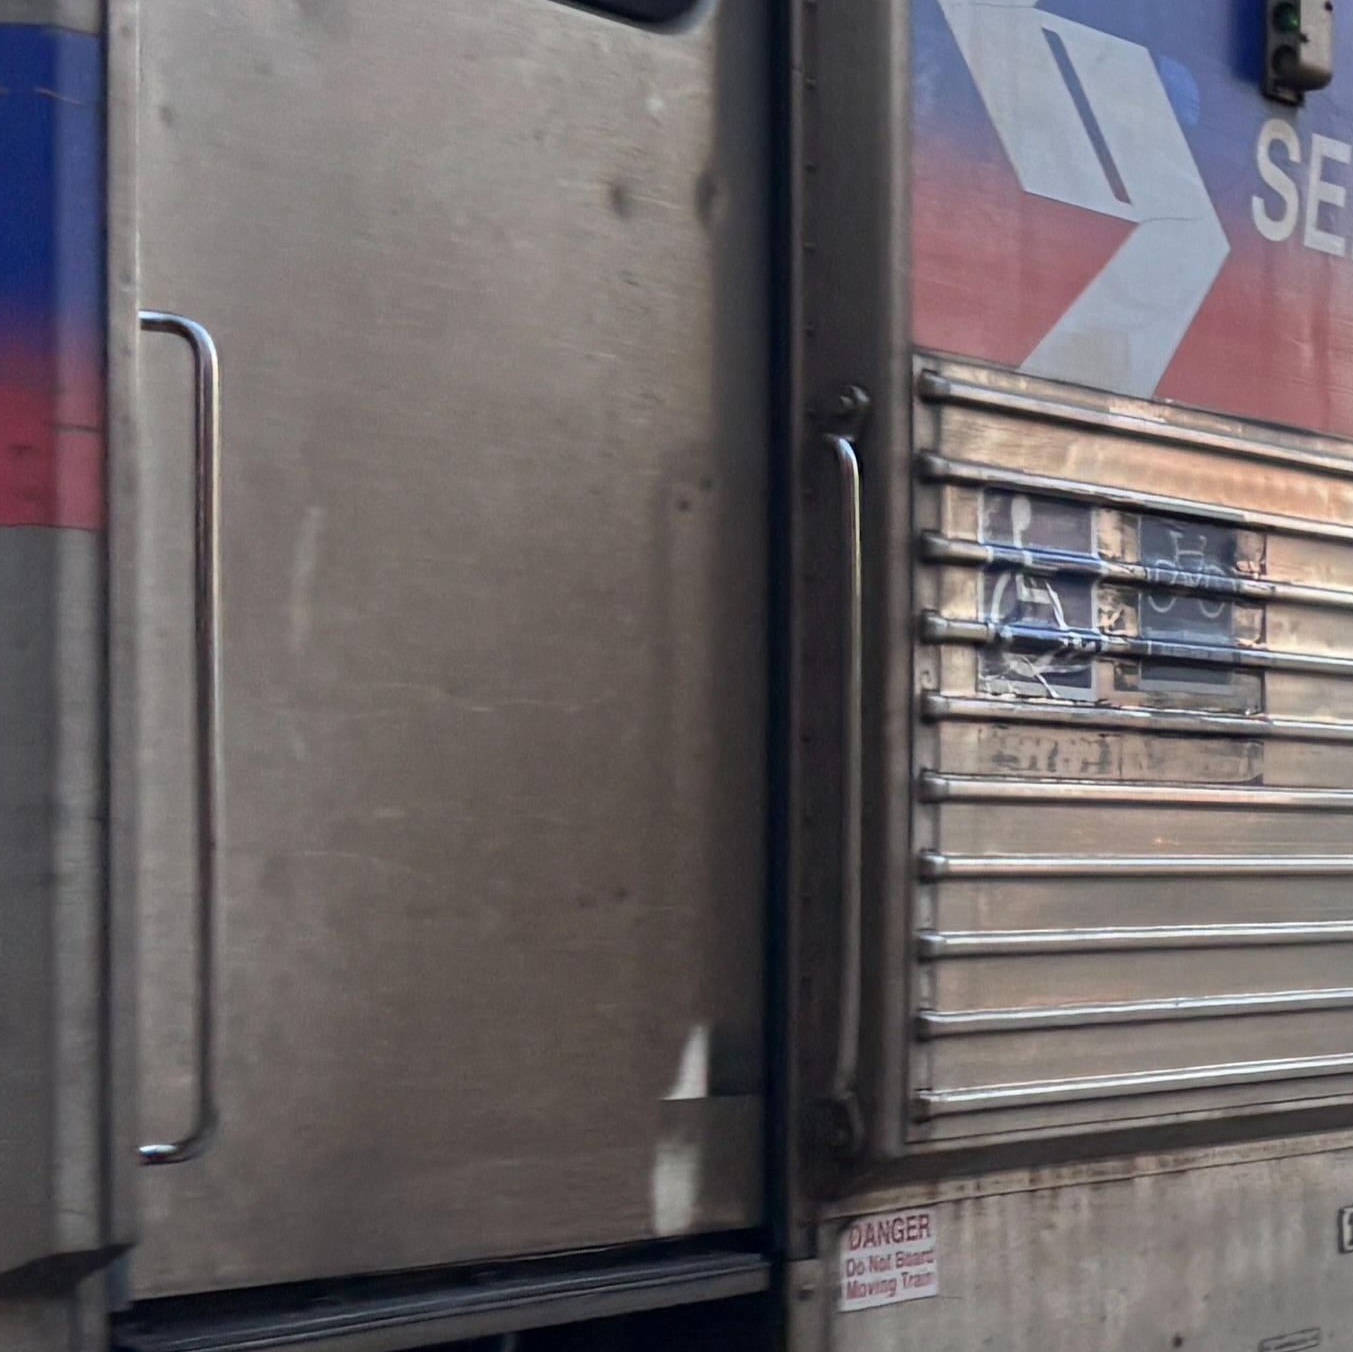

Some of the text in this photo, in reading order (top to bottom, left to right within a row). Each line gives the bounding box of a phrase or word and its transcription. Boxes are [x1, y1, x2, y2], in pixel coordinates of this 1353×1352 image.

[848, 1213, 932, 1251] DANGER
[846, 1258, 865, 1278] Do
[869, 1253, 892, 1272] Not
[845, 1276, 898, 1299] Moving
